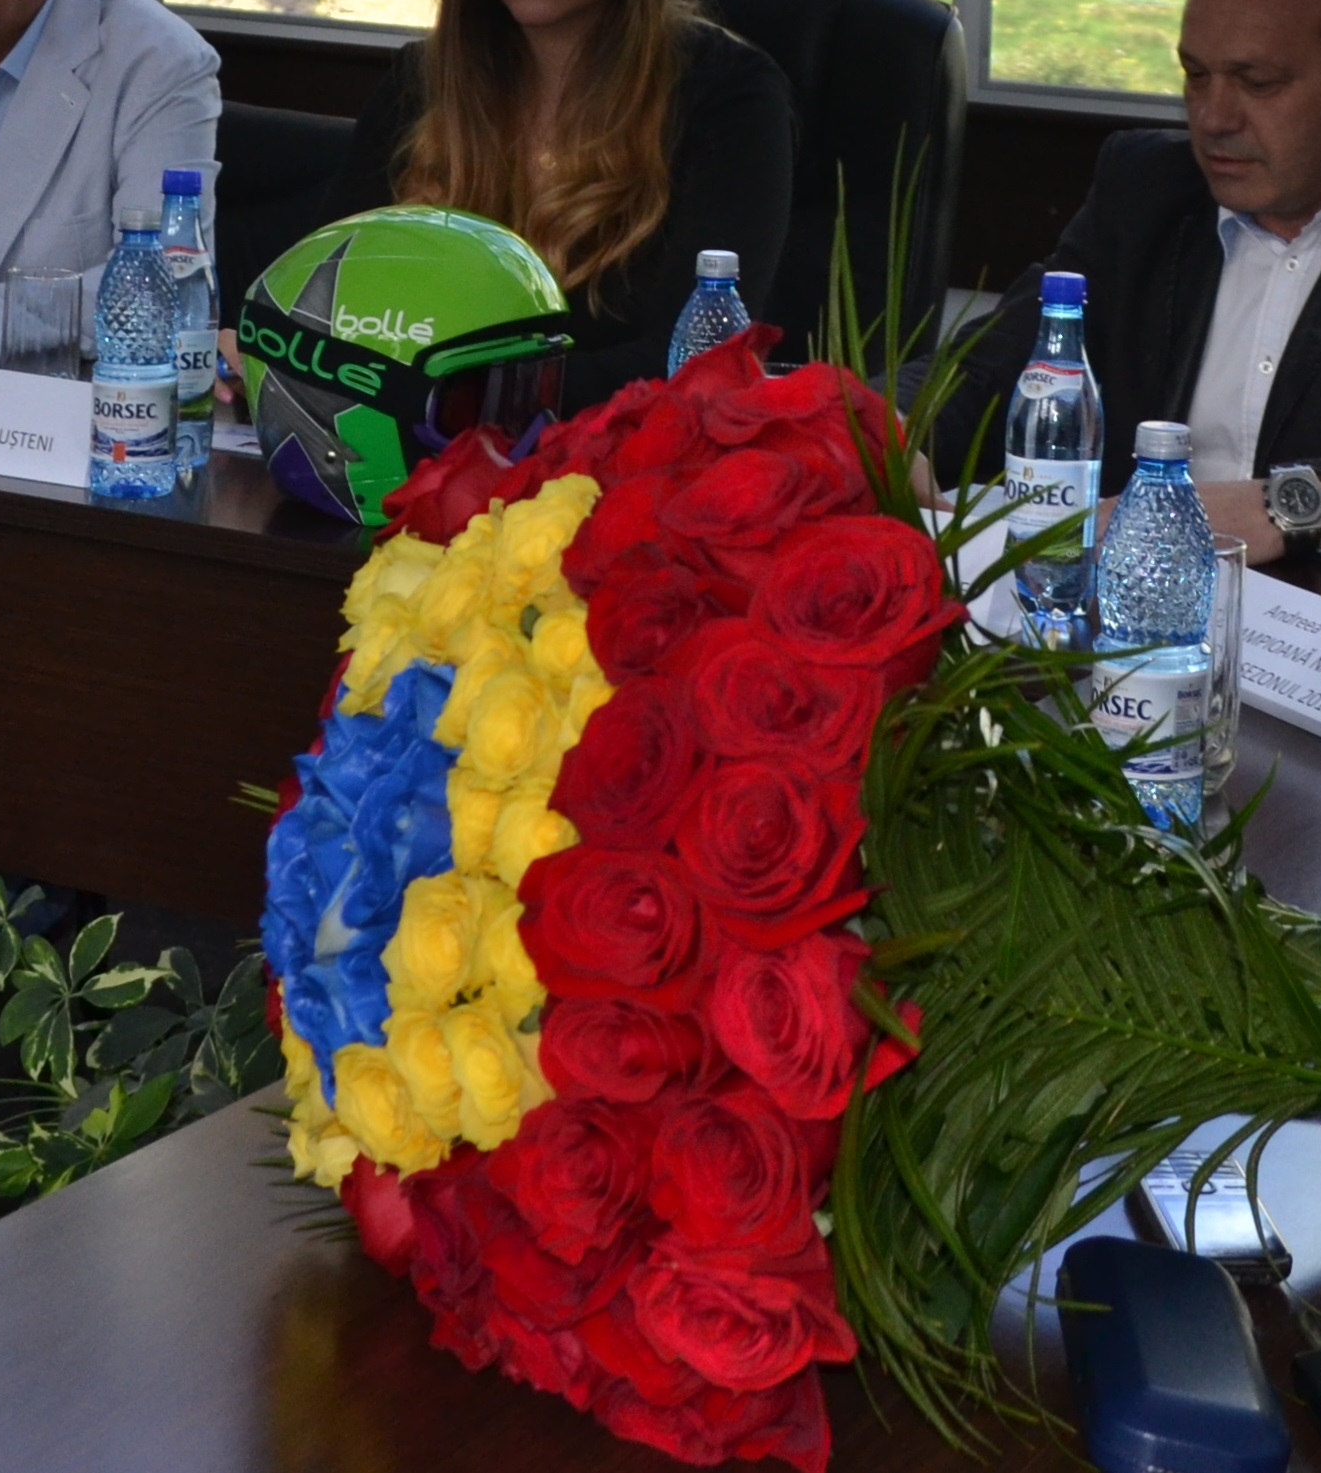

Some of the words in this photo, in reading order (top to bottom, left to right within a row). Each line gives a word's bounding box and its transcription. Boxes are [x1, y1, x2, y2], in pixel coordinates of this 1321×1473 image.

[335, 304, 435, 345] bollé
[180, 349, 212, 370] SEC
[238, 304, 387, 397] bollé
[93, 397, 158, 420] BORSEC
[1005, 478, 1077, 508] ORSEC
[1239, 660, 1301, 701] SEZONUL
[1090, 685, 1153, 721] ORSEC
